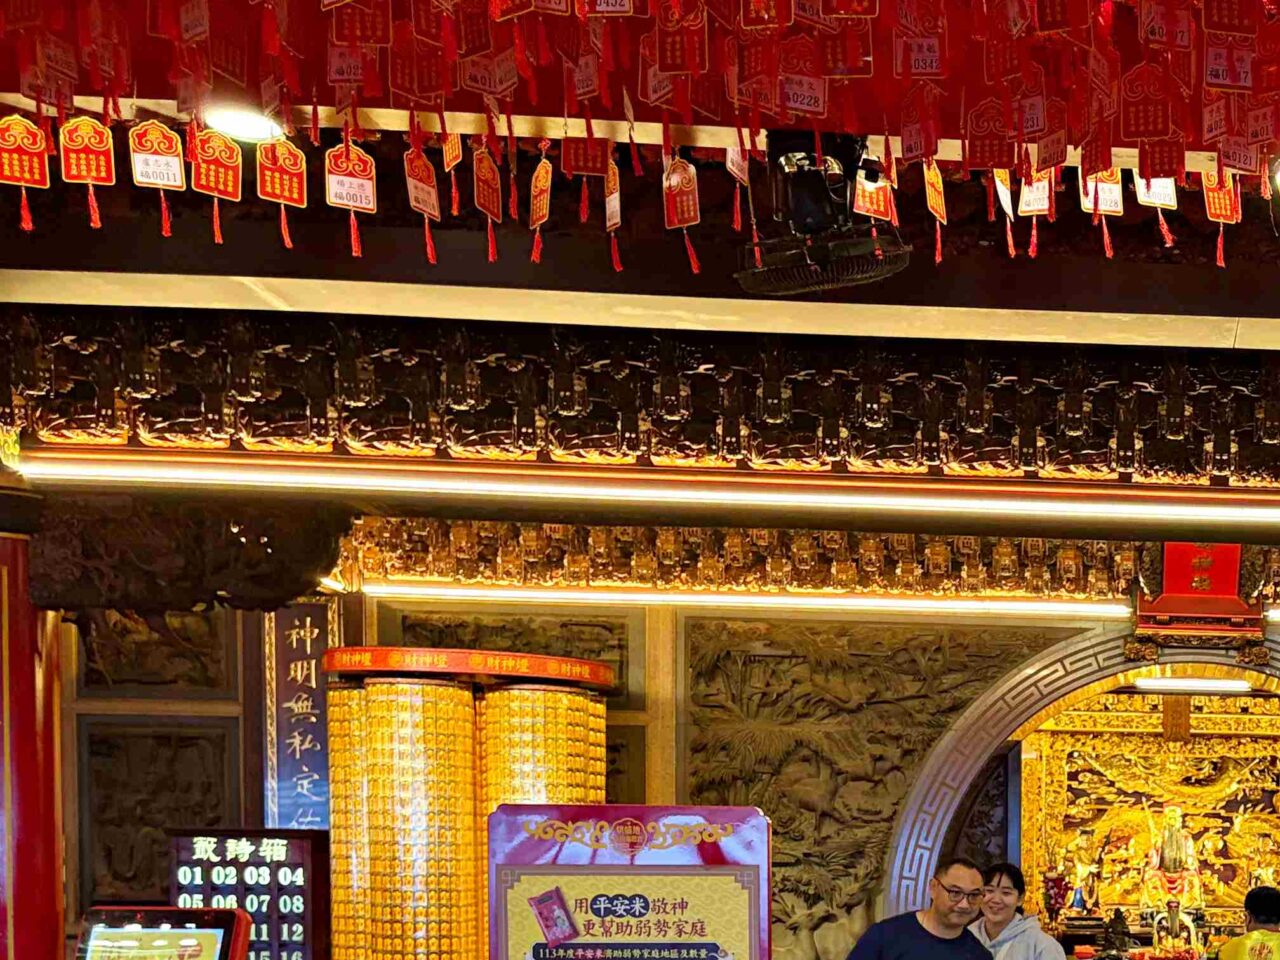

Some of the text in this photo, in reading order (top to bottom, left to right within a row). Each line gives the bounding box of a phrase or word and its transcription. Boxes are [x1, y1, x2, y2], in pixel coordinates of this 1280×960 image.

[177, 866, 305, 886] 01 02 03 04
[178, 894, 305, 914] 05 06 07 08
[573, 896, 690, 916] 用平安米敬神
[280, 923, 304, 941] 12
[581, 919, 709, 939] 更幫助弱勢家庭
